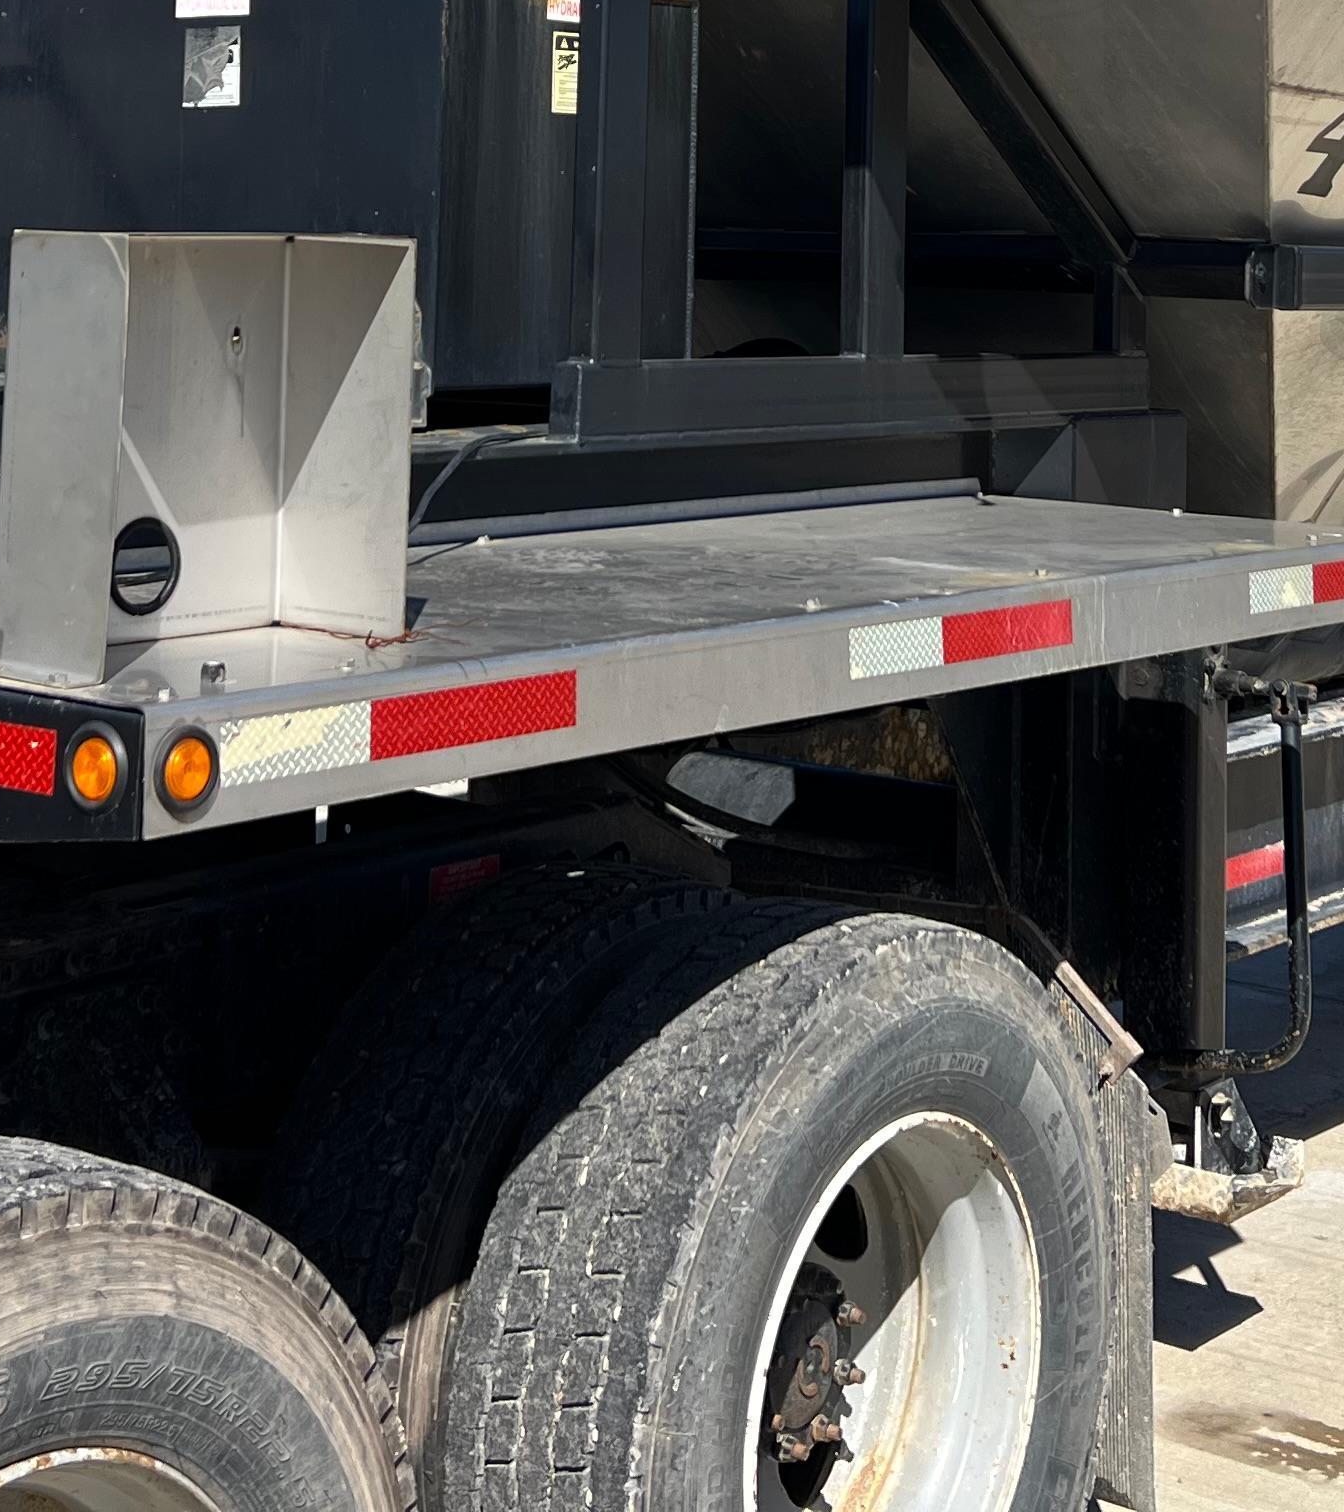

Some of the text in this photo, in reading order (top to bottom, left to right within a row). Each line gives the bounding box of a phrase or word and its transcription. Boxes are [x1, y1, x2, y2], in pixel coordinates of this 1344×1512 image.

[549, 0, 582, 17] HYDRA
[948, 1053, 985, 1075] DRIVE
[40, 1360, 316, 1507] 295/75R22.5
